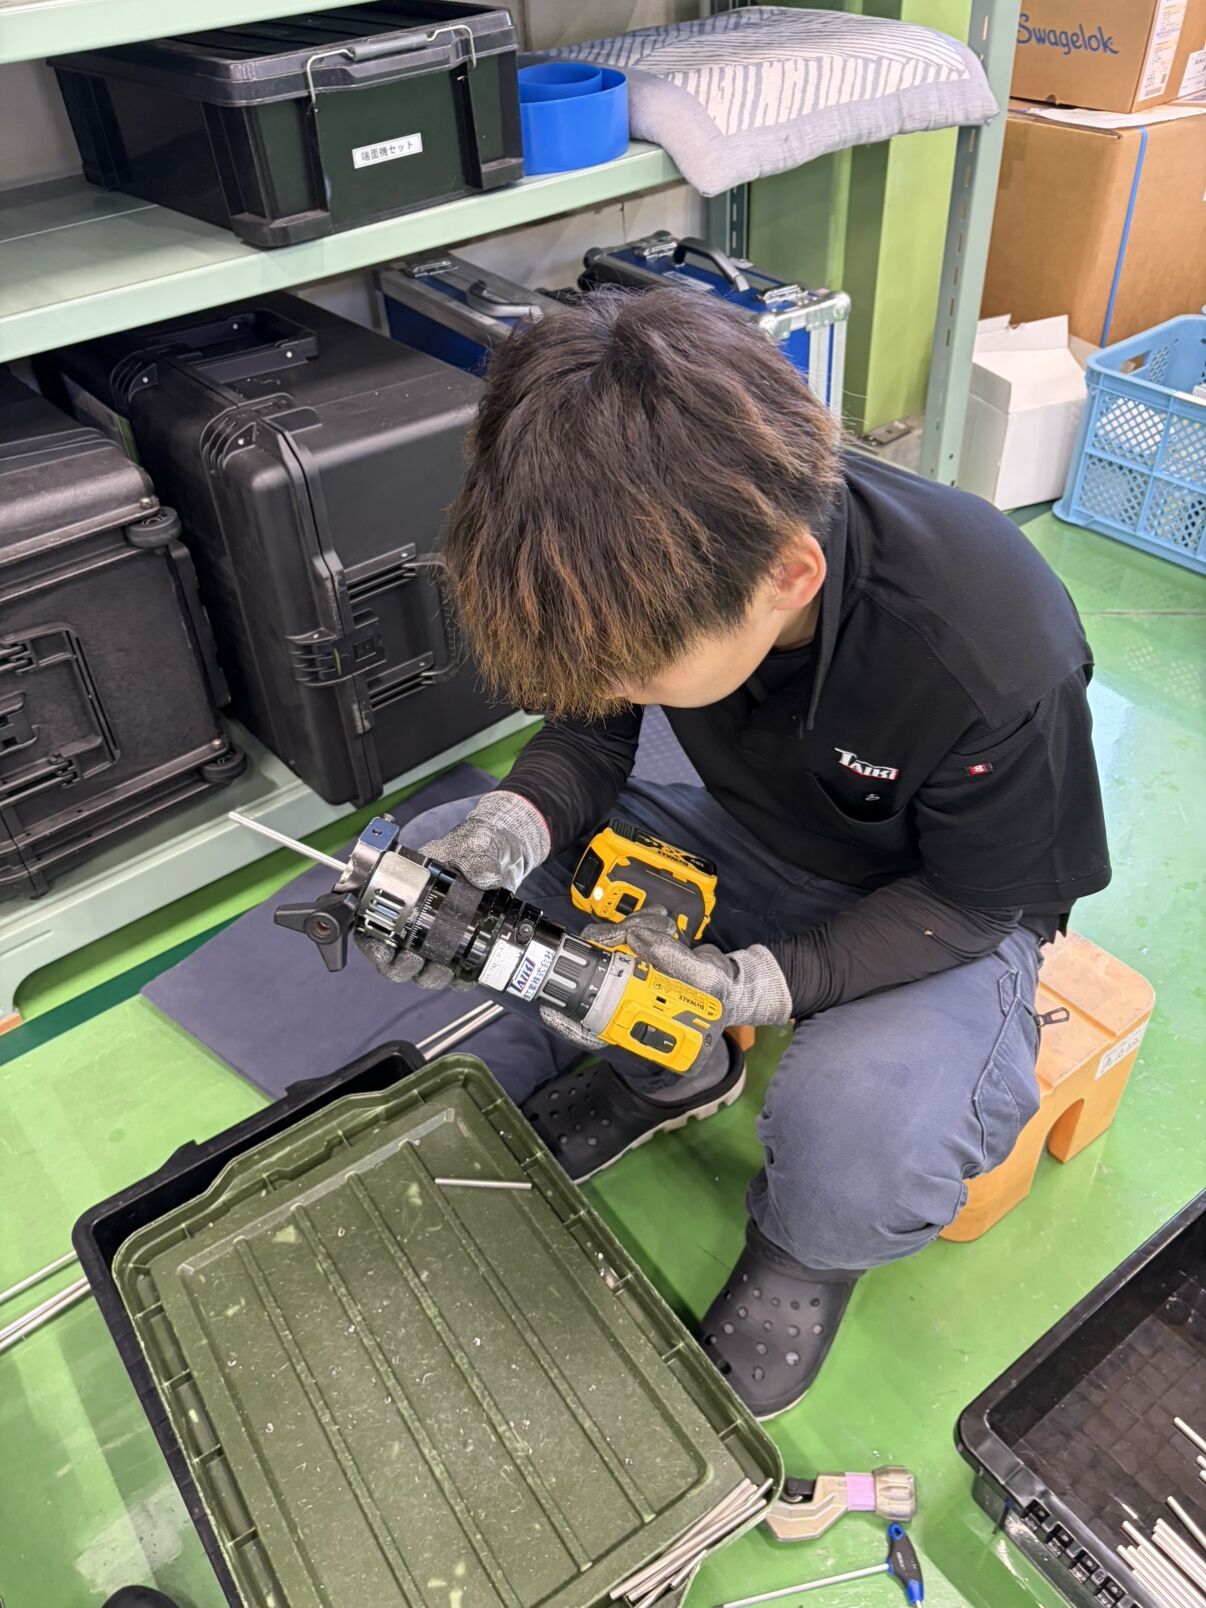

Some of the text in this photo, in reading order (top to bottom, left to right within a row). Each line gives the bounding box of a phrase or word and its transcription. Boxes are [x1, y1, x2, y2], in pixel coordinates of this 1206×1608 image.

[1016, 12, 1119, 55] Swagelok
[361, 140, 413, 161] 端面機セット
[834, 747, 899, 781] TAIKI
